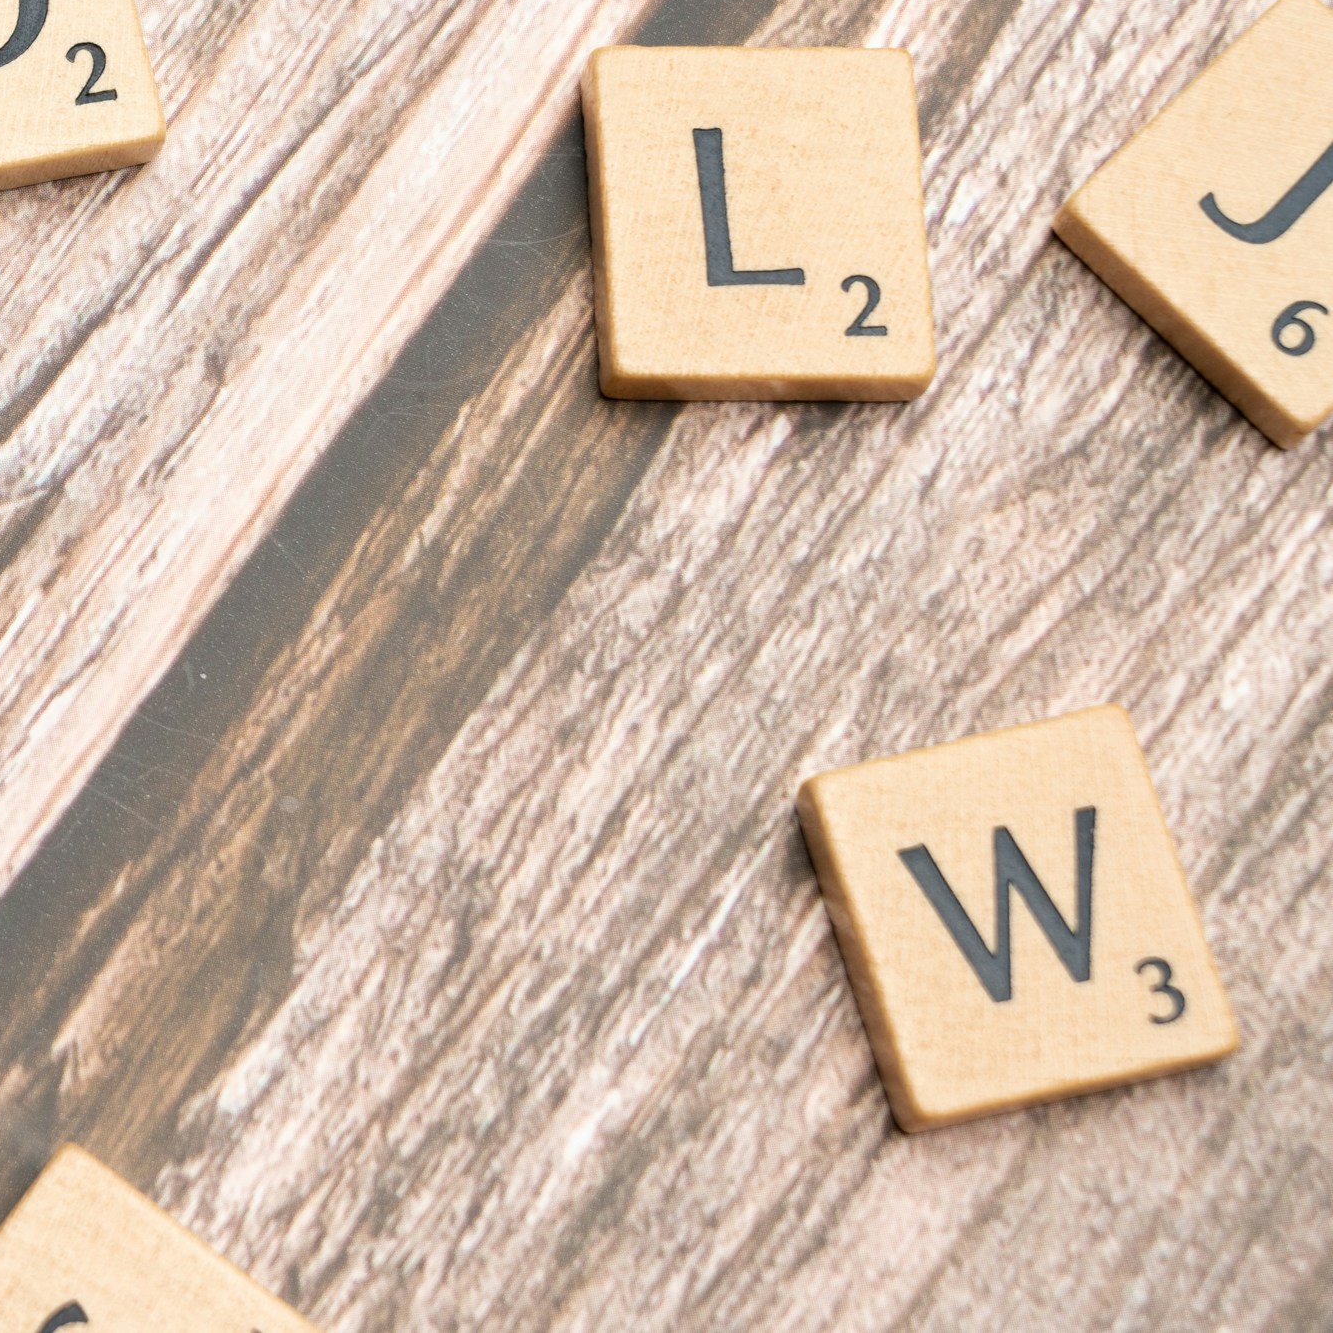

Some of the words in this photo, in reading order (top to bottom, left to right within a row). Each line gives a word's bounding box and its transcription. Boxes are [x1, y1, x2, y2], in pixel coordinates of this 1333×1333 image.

[65, 42, 118, 105] 2
[692, 127, 806, 287] L
[841, 274, 888, 336] 2
[1271, 300, 1329, 356] 6
[897, 805, 1097, 1003] W
[1136, 957, 1186, 1025] 3
